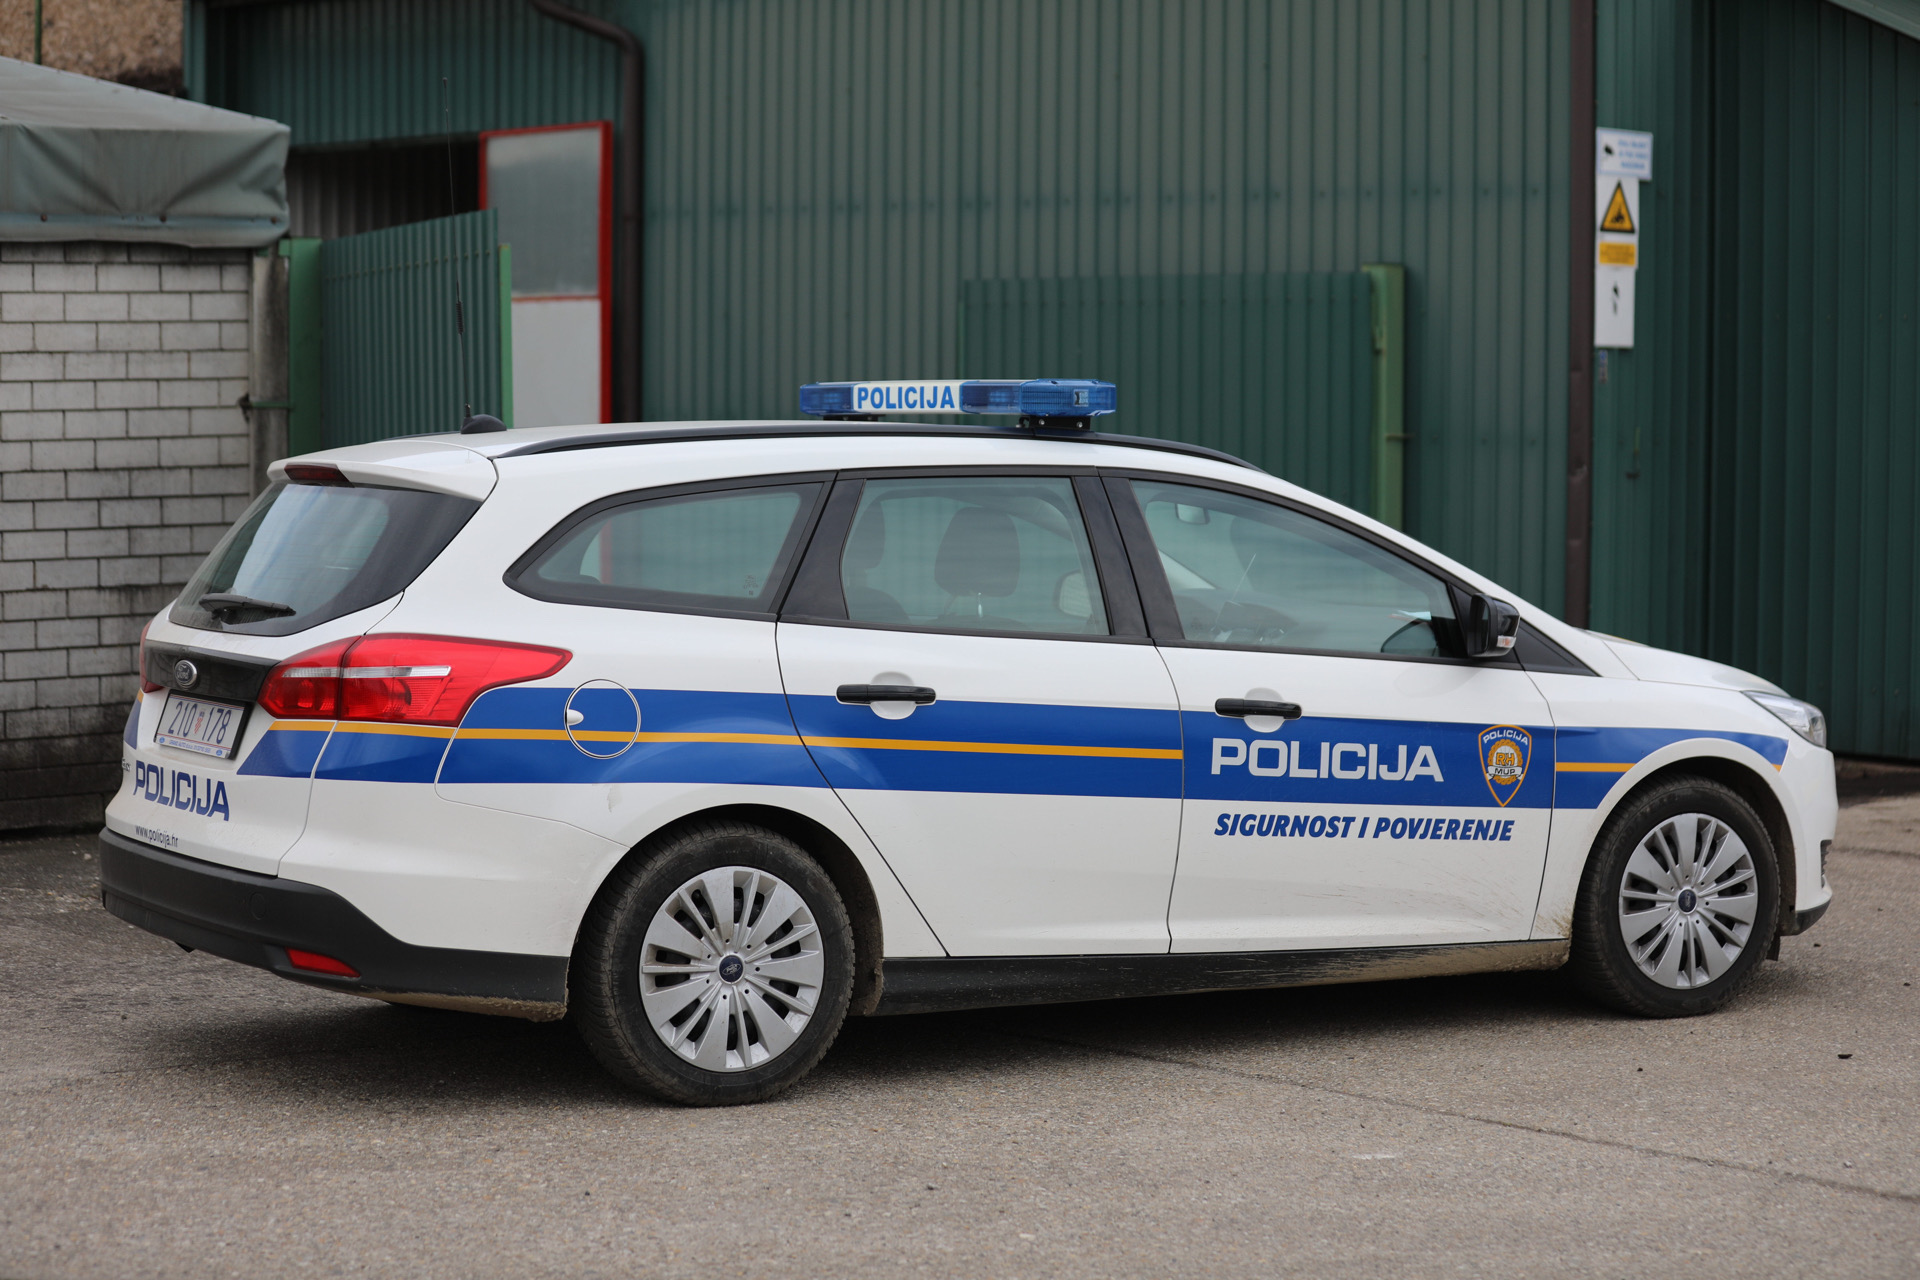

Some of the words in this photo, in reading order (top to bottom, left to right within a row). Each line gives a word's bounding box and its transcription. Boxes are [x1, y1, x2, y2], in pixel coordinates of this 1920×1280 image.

[857, 385, 955, 409] POLICIJA
[168, 701, 198, 738] 210
[202, 707, 232, 745] 178
[1483, 729, 1529, 746] POLICIJA
[1211, 737, 1444, 782] POLICIJA
[1494, 767, 1516, 775] MUP
[1496, 752, 1515, 767] RH
[133, 760, 230, 822] POLICIJA
[135, 825, 179, 848] www.policija.hr
[1214, 813, 1356, 838] SIGURNOST
[1358, 816, 1369, 838] I
[1373, 817, 1515, 841] POVJERENJE
